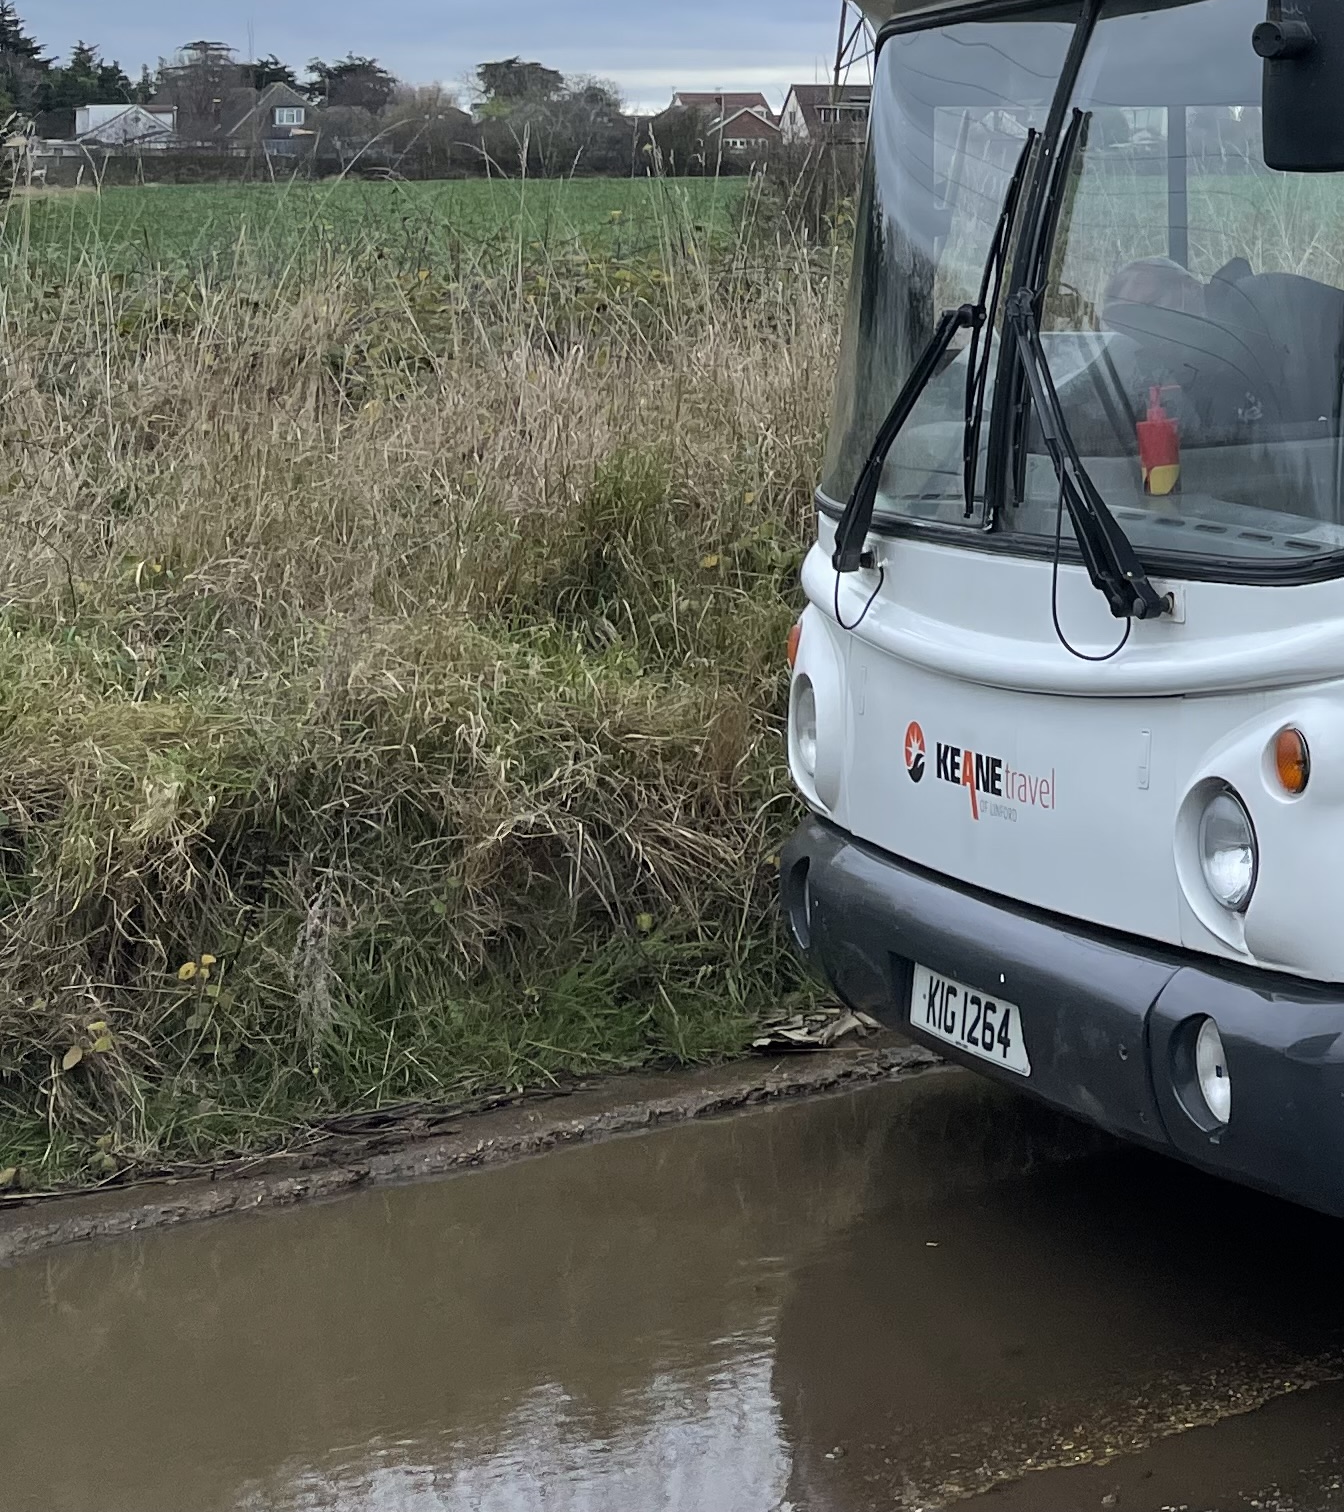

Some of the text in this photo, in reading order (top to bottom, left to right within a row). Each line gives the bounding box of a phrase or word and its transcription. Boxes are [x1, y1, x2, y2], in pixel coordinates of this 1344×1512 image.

[936, 741, 1055, 821] KEANE travel
[979, 799, 1018, 823] OF LINFORD
[926, 975, 1011, 1059] KIG 1264
